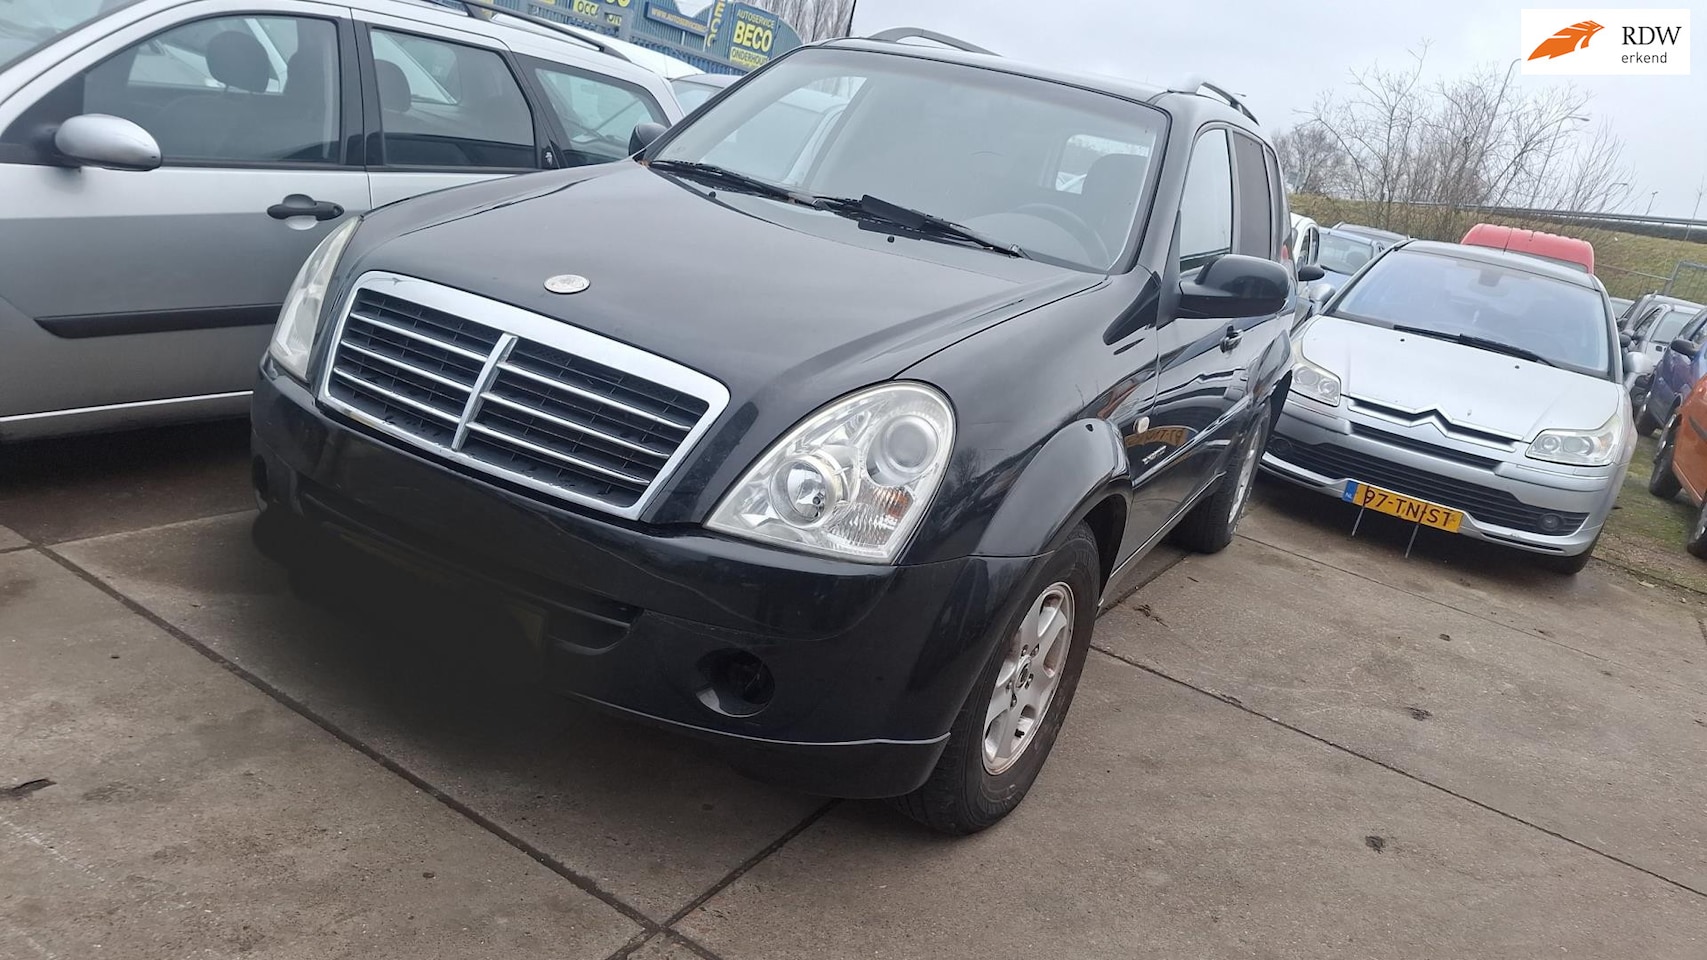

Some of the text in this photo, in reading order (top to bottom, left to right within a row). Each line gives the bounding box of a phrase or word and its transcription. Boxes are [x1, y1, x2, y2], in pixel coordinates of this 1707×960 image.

[737, 9, 776, 29] AUTOSERVICE
[733, 20, 773, 52] BECO
[1363, 489, 1453, 528] 97-TN-ST
